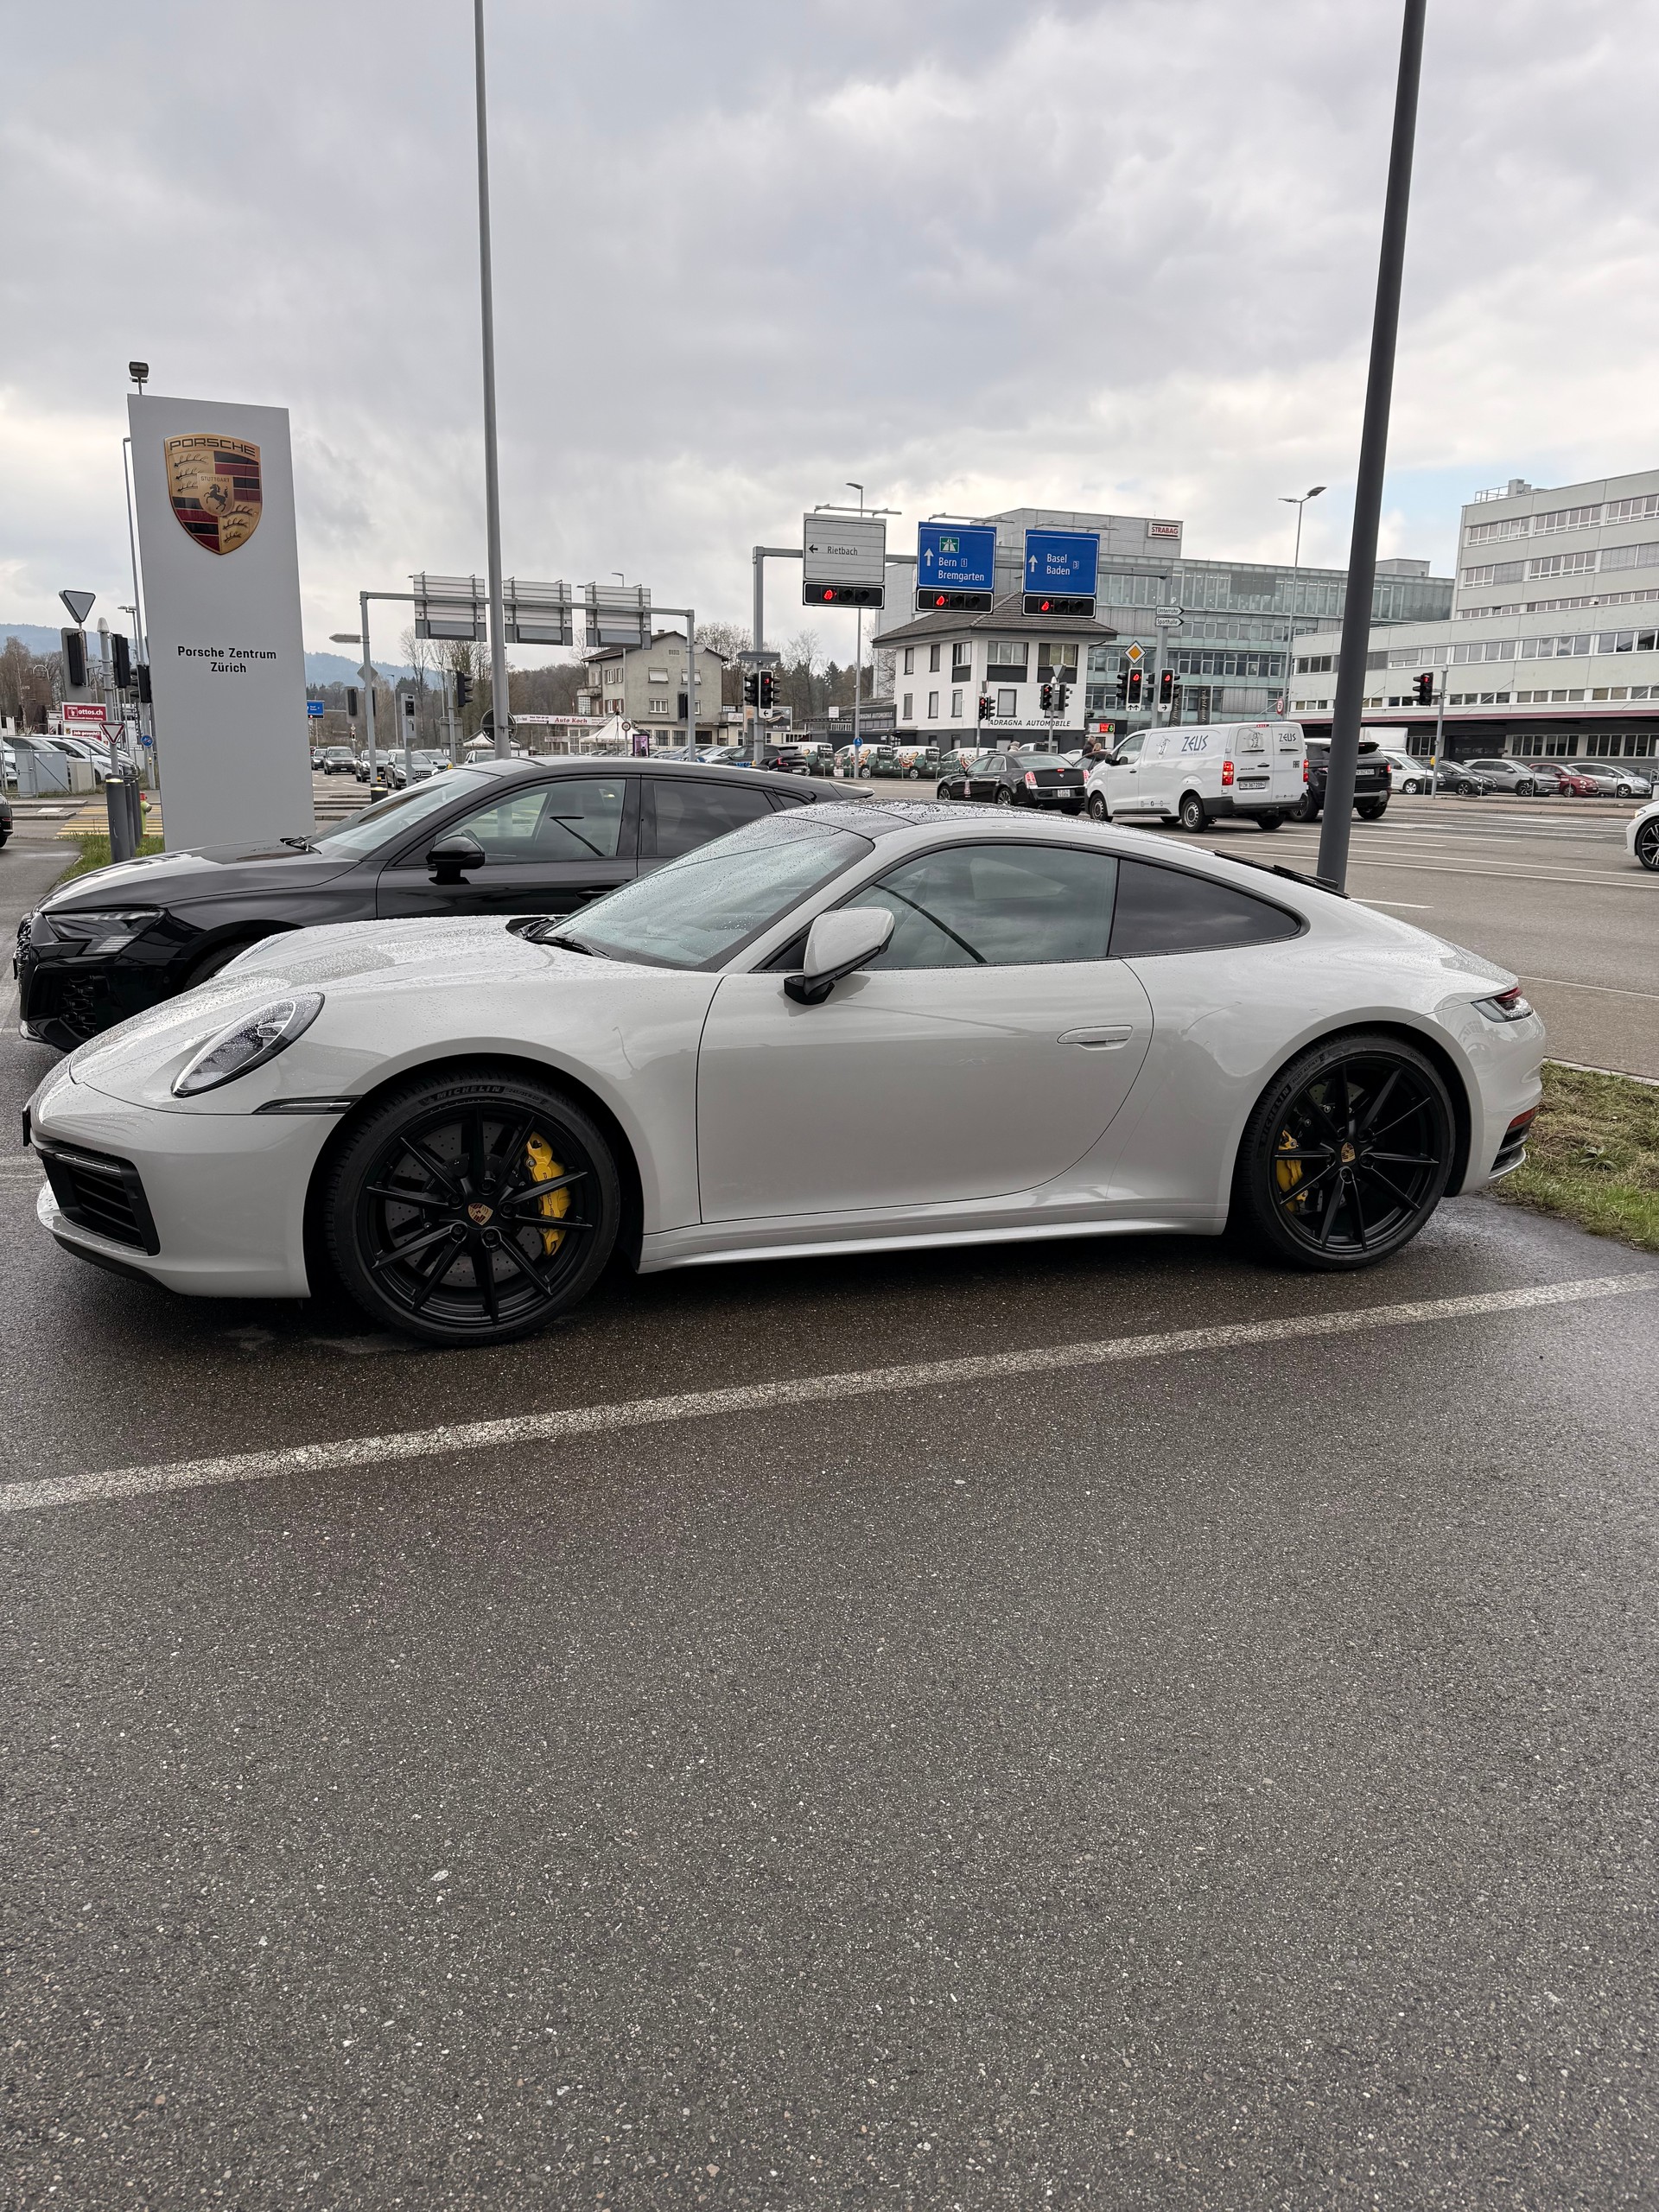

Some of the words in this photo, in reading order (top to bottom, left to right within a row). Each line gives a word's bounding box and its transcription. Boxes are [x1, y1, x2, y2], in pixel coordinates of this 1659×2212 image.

[169, 438, 256, 456] PORSCHE
[1151, 526, 1179, 535] STRABAG
[827, 546, 858, 556] Rietbach
[938, 556, 957, 567] Bern
[1046, 553, 1067, 563] Basel
[938, 569, 985, 582] Bremgarten
[1046, 565, 1071, 575] Baden
[177, 645, 225, 658] Porsche
[228, 647, 276, 659] Zentrum
[210, 662, 246, 672] Zürich
[1181, 735, 1209, 752] ZEUS
[1279, 733, 1296, 742] ZEUS
[436, 1085, 501, 1100] MICHELIN
[1260, 1086, 1290, 1144] MICHELIN
[543, 1172, 555, 1217] PSCHE
